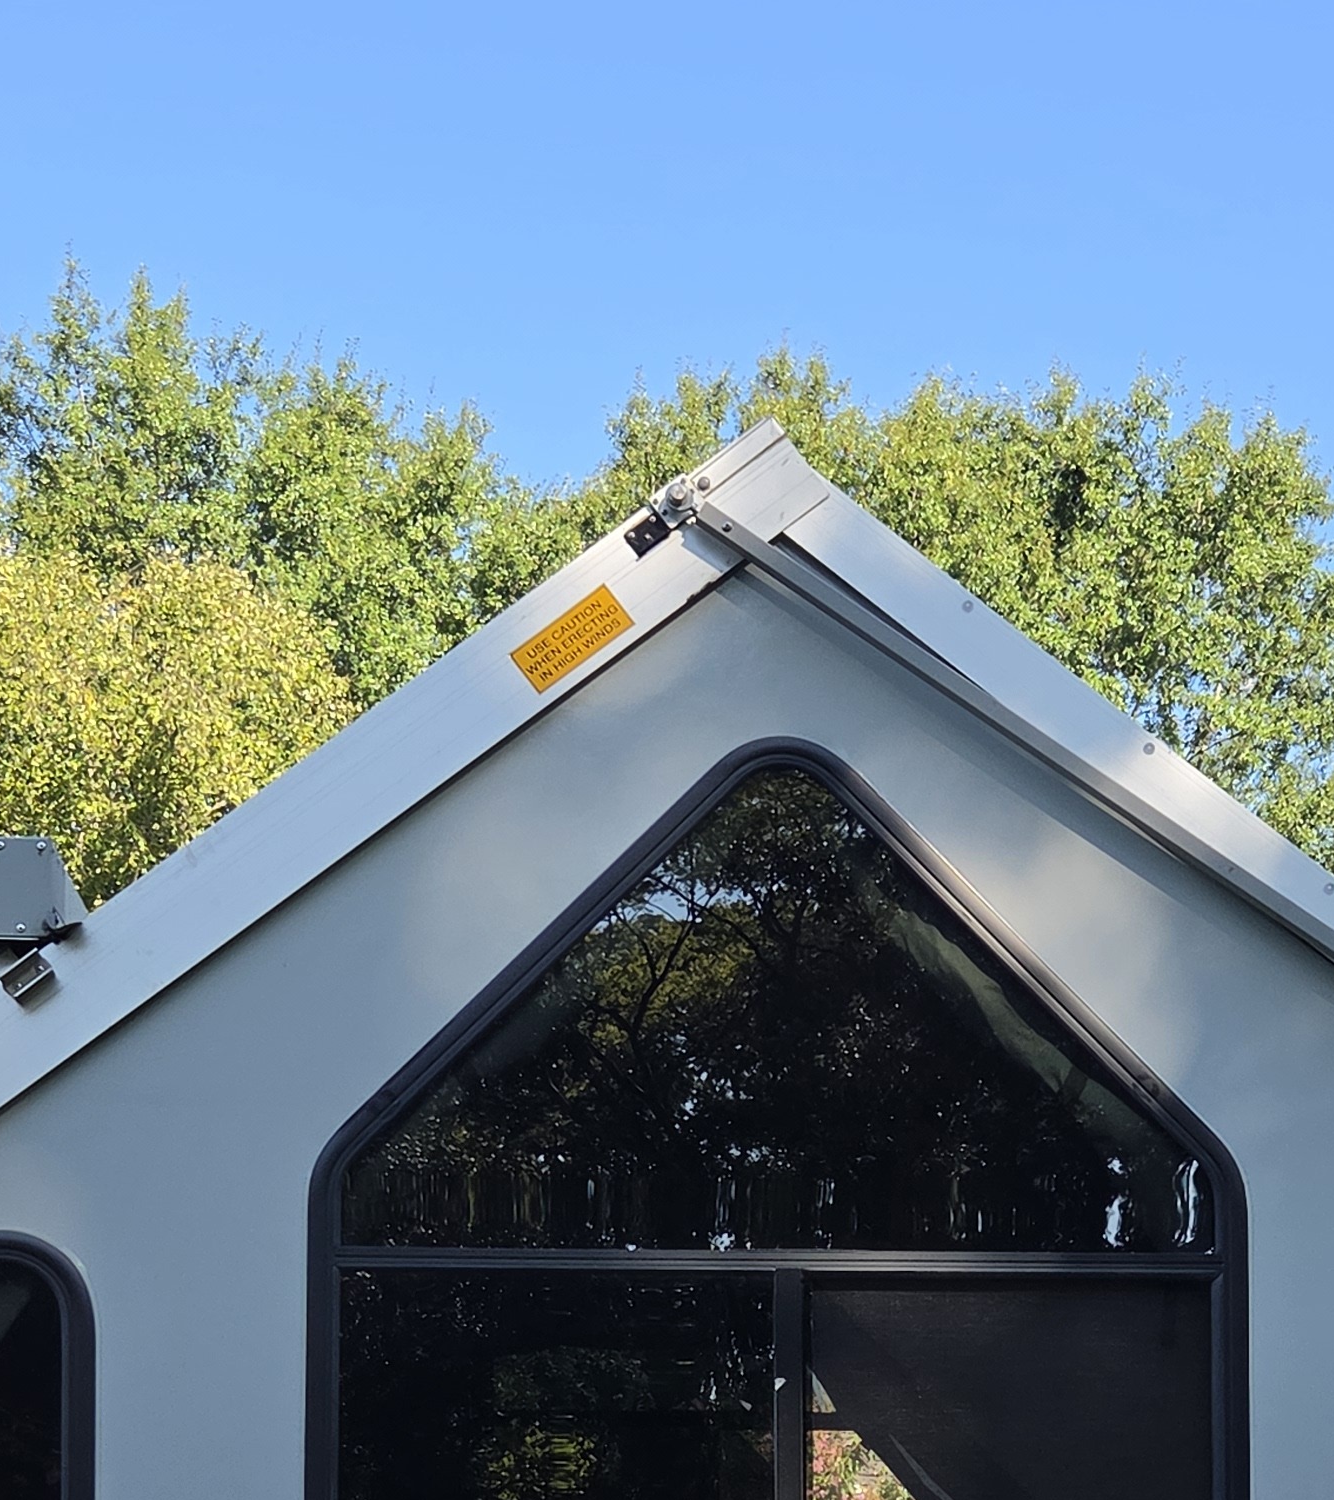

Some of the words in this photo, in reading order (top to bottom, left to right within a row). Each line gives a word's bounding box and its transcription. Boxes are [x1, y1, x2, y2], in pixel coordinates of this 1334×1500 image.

[525, 646, 562, 676] WHEN
[562, 603, 619, 649] ERECTING
[526, 637, 552, 660] USE
[551, 600, 602, 642] CAUTION
[538, 670, 554, 683] IN
[554, 646, 584, 672] HIGH
[582, 618, 621, 650] WINDS
